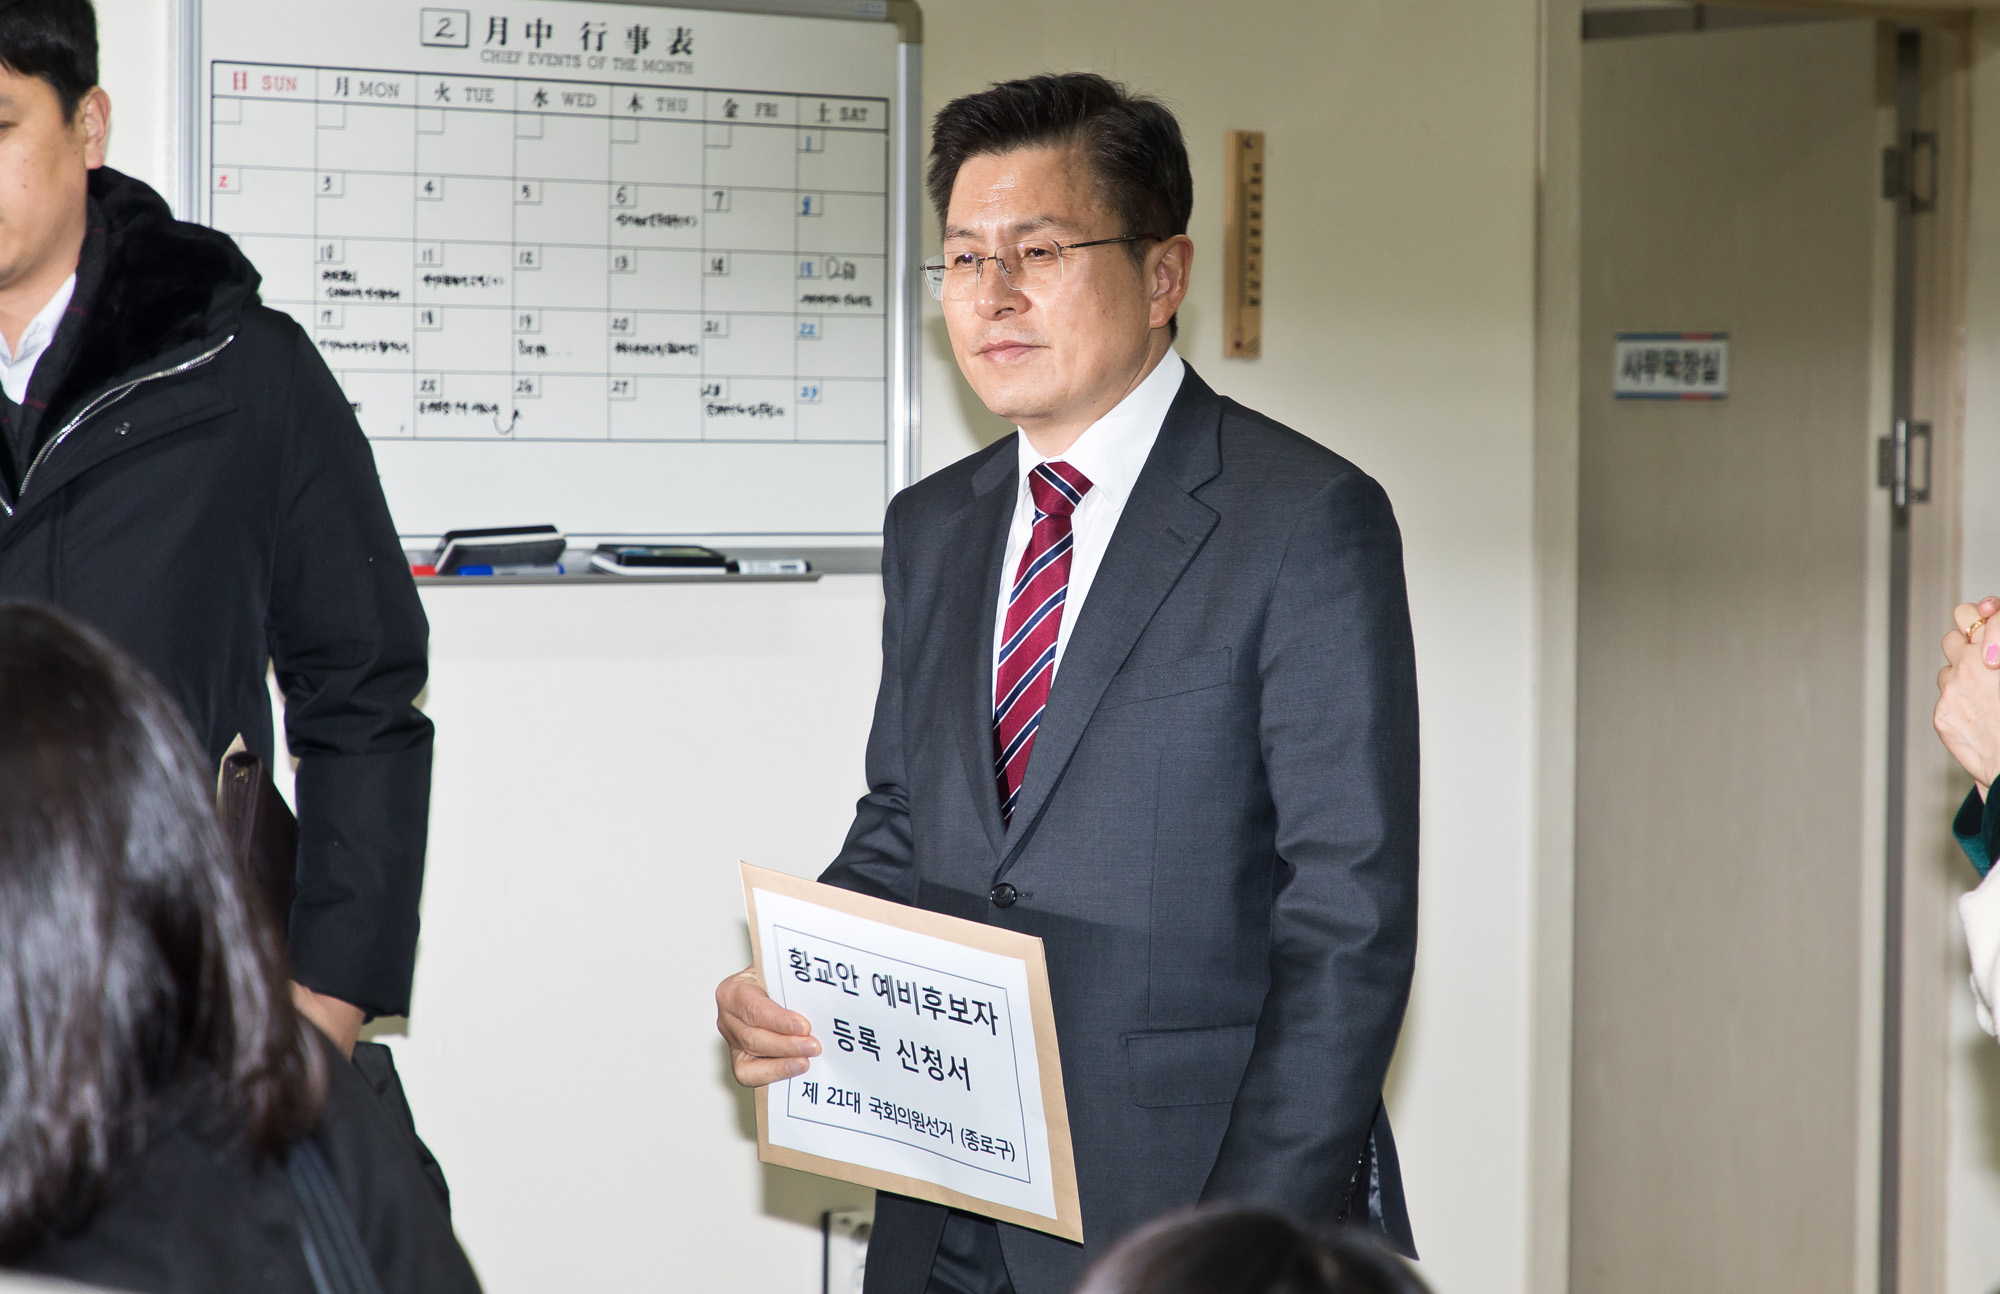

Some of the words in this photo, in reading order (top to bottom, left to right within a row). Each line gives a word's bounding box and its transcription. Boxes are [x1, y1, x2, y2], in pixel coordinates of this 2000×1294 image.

[434, 17, 456, 39] 2
[481, 49, 522, 64] CHIEF
[526, 50, 581, 69] EVENTS
[587, 56, 606, 70] OF
[613, 57, 637, 72] THE
[643, 59, 694, 73] MONTH
[262, 76, 298, 92] SUN
[334, 76, 349, 97] 月
[359, 82, 400, 98] MON
[435, 83, 450, 102] 火
[464, 87, 494, 102] TUE
[533, 88, 549, 107] 水
[562, 92, 597, 107] WED
[628, 93, 643, 112] 木
[656, 97, 689, 113] THU
[723, 98, 739, 117] 金
[755, 102, 778, 117] FRI
[817, 103, 830, 122] 土
[839, 106, 868, 121] SAT
[804, 136, 812, 151] 1
[217, 175, 228, 188] 2
[322, 176, 332, 190] 3
[424, 181, 434, 194] 4
[522, 185, 530, 198] 5
[616, 186, 627, 203] 6
[713, 191, 724, 210] 7
[423, 249, 433, 263] 11
[519, 250, 533, 264] 12
[615, 256, 628, 270] 13
[321, 311, 332, 323] 17
[422, 311, 433, 324] 18
[519, 314, 531, 329] 19
[612, 318, 628, 331] 20
[704, 320, 719, 332] 21
[800, 323, 815, 336] 22
[419, 379, 435, 392] 25
[516, 379, 533, 393] 26
[612, 381, 628, 393] 27
[801, 386, 817, 399] 29
[788, 947, 859, 996] 황교안
[872, 971, 998, 1036] 예비후보자
[833, 1018, 881, 1060] 등록
[897, 1039, 971, 1091] 신청서
[802, 1080, 819, 1104] 제
[827, 1086, 861, 1114] 21대
[868, 1096, 954, 1144] 국회의원선거
[960, 1128, 1016, 1162] (종로구)
